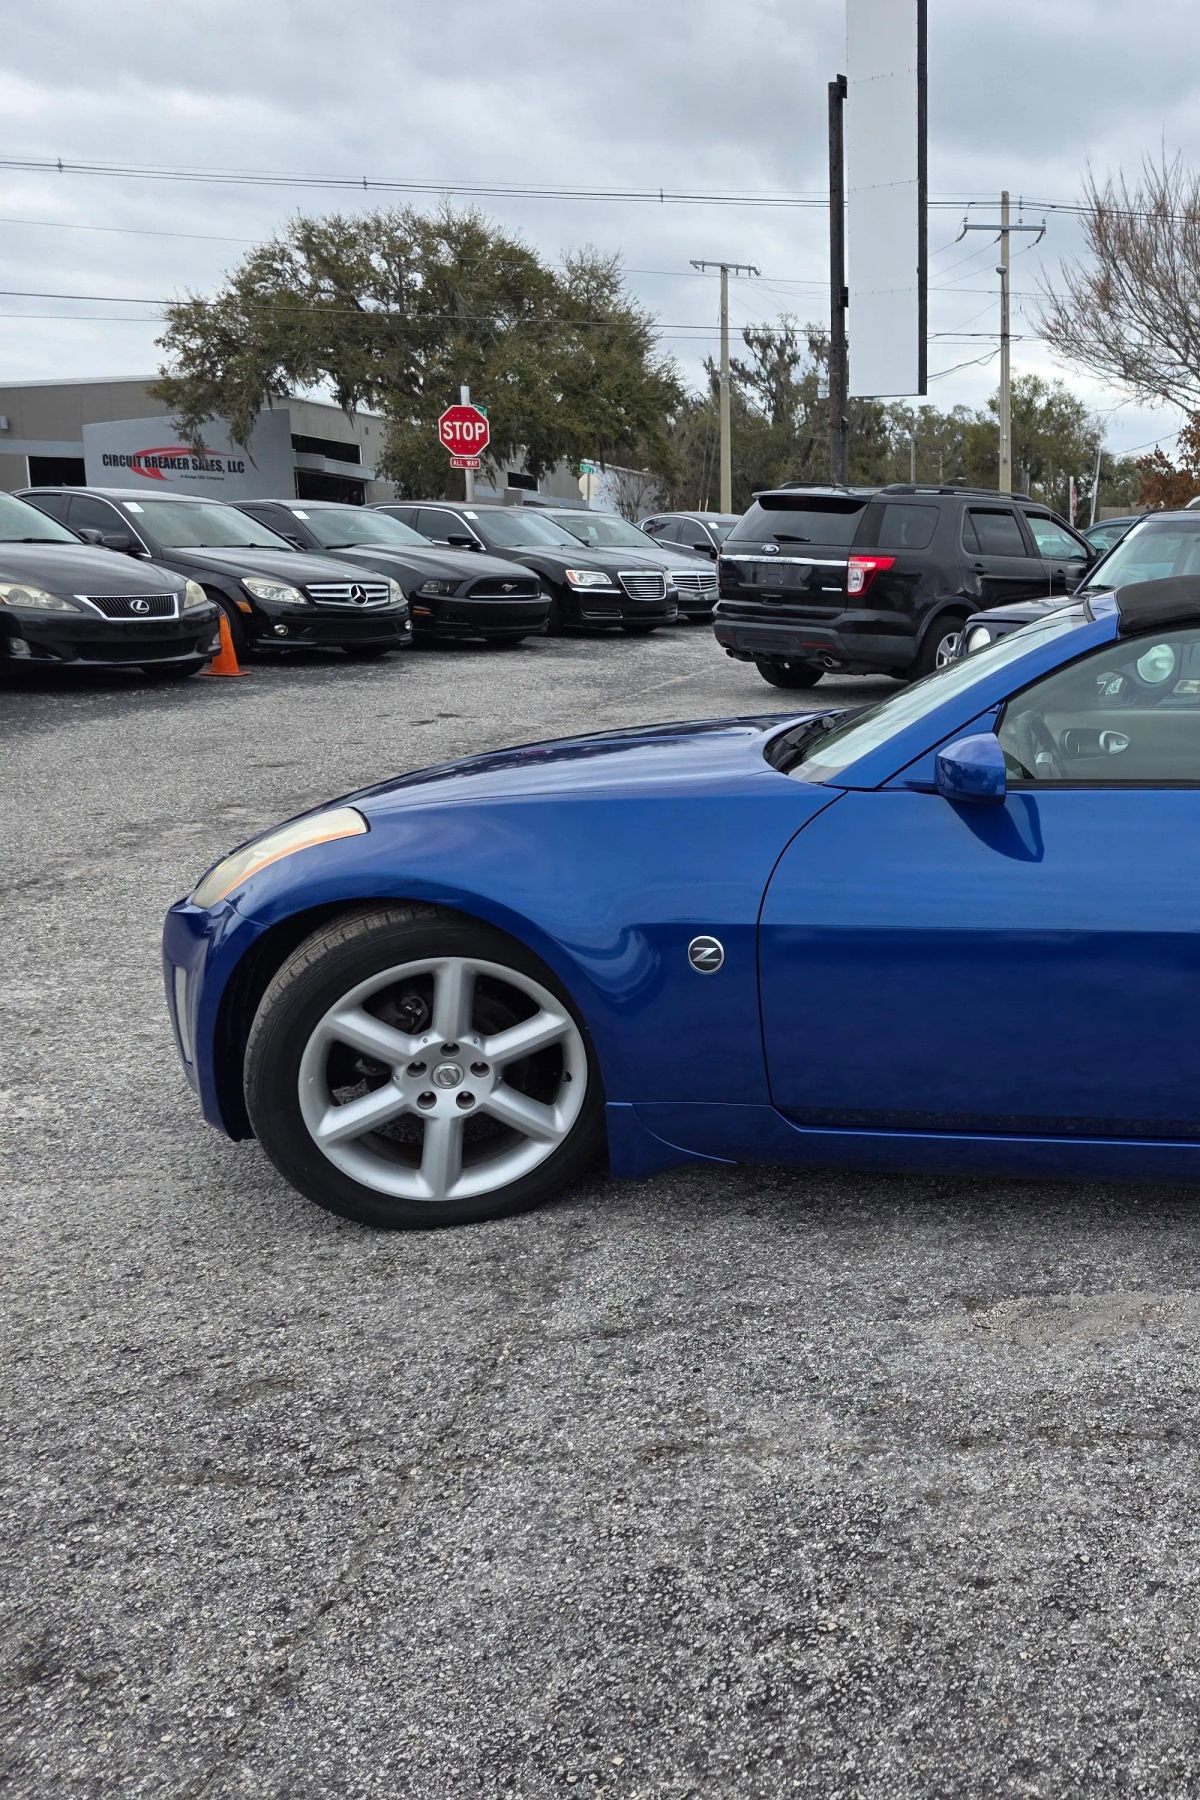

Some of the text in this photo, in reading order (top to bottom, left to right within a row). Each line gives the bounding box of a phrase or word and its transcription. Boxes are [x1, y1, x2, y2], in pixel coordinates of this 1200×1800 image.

[443, 421, 486, 440] STOP
[102, 454, 245, 473] CIRCUIT BREAKER SALES, LLC
[692, 947, 720, 962] Z
